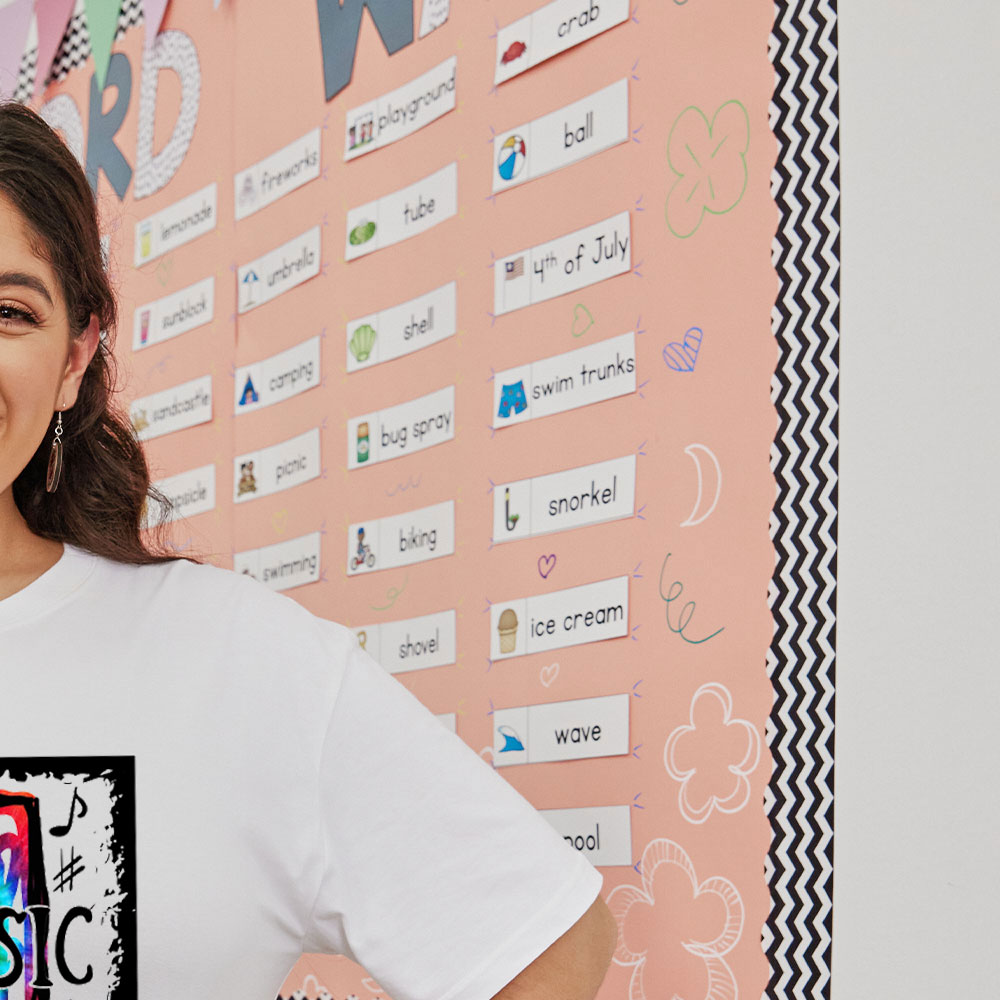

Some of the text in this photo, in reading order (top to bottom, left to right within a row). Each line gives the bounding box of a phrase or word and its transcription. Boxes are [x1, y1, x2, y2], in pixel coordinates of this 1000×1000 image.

[557, 0, 601, 38] crab
[377, 66, 456, 135] playground
[564, 111, 594, 148] ball
[261, 147, 318, 192] fireworks
[161, 200, 213, 240] lemonade
[404, 195, 435, 225] tube
[267, 246, 315, 287] umbrella
[534, 230, 629, 283] 4th of July
[162, 291, 209, 330] sunblock
[404, 305, 433, 341] shell
[269, 361, 314, 391] camping
[532, 352, 635, 400] swim trunks
[152, 390, 209, 422] sandcastle
[381, 410, 451, 448] bug spray
[276, 454, 307, 484] picnic
[549, 475, 617, 516] snorkel
[399, 526, 437, 552] biking
[263, 553, 317, 582] swimming
[531, 604, 623, 638] ice cream
[399, 627, 439, 659] shovel
[555, 724, 602, 745] wave
